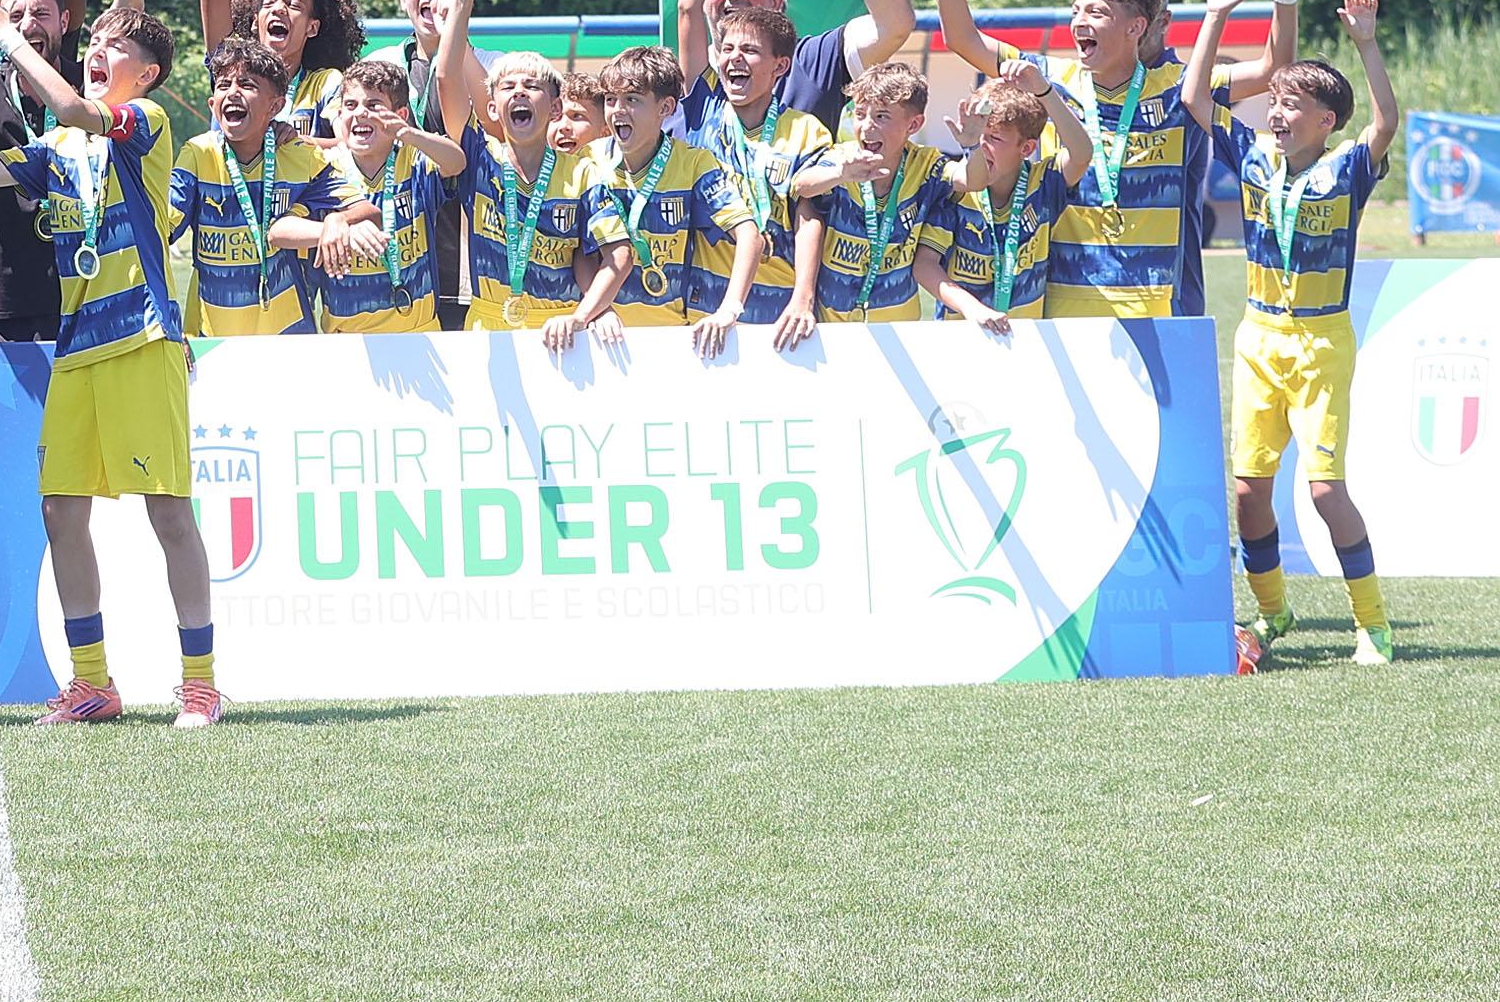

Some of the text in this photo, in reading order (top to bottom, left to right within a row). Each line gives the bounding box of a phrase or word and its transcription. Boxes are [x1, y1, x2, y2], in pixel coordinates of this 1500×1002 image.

[264, 157, 275, 198] FINALE
[384, 165, 395, 194] 2026
[527, 151, 556, 219] FINALE 2026
[1012, 169, 1028, 209] FINALE
[866, 205, 878, 245] FINALE
[1007, 214, 1021, 245] 2026
[1420, 363, 1482, 384] ITALIA
[191, 458, 252, 483] ALIA
[294, 419, 818, 485] FAIR PLAY ELITE
[296, 481, 821, 581] UNDER 13
[351, 587, 549, 625] GIOVANILE
[563, 586, 584, 620] E
[596, 581, 827, 620] SCOLASTICO
